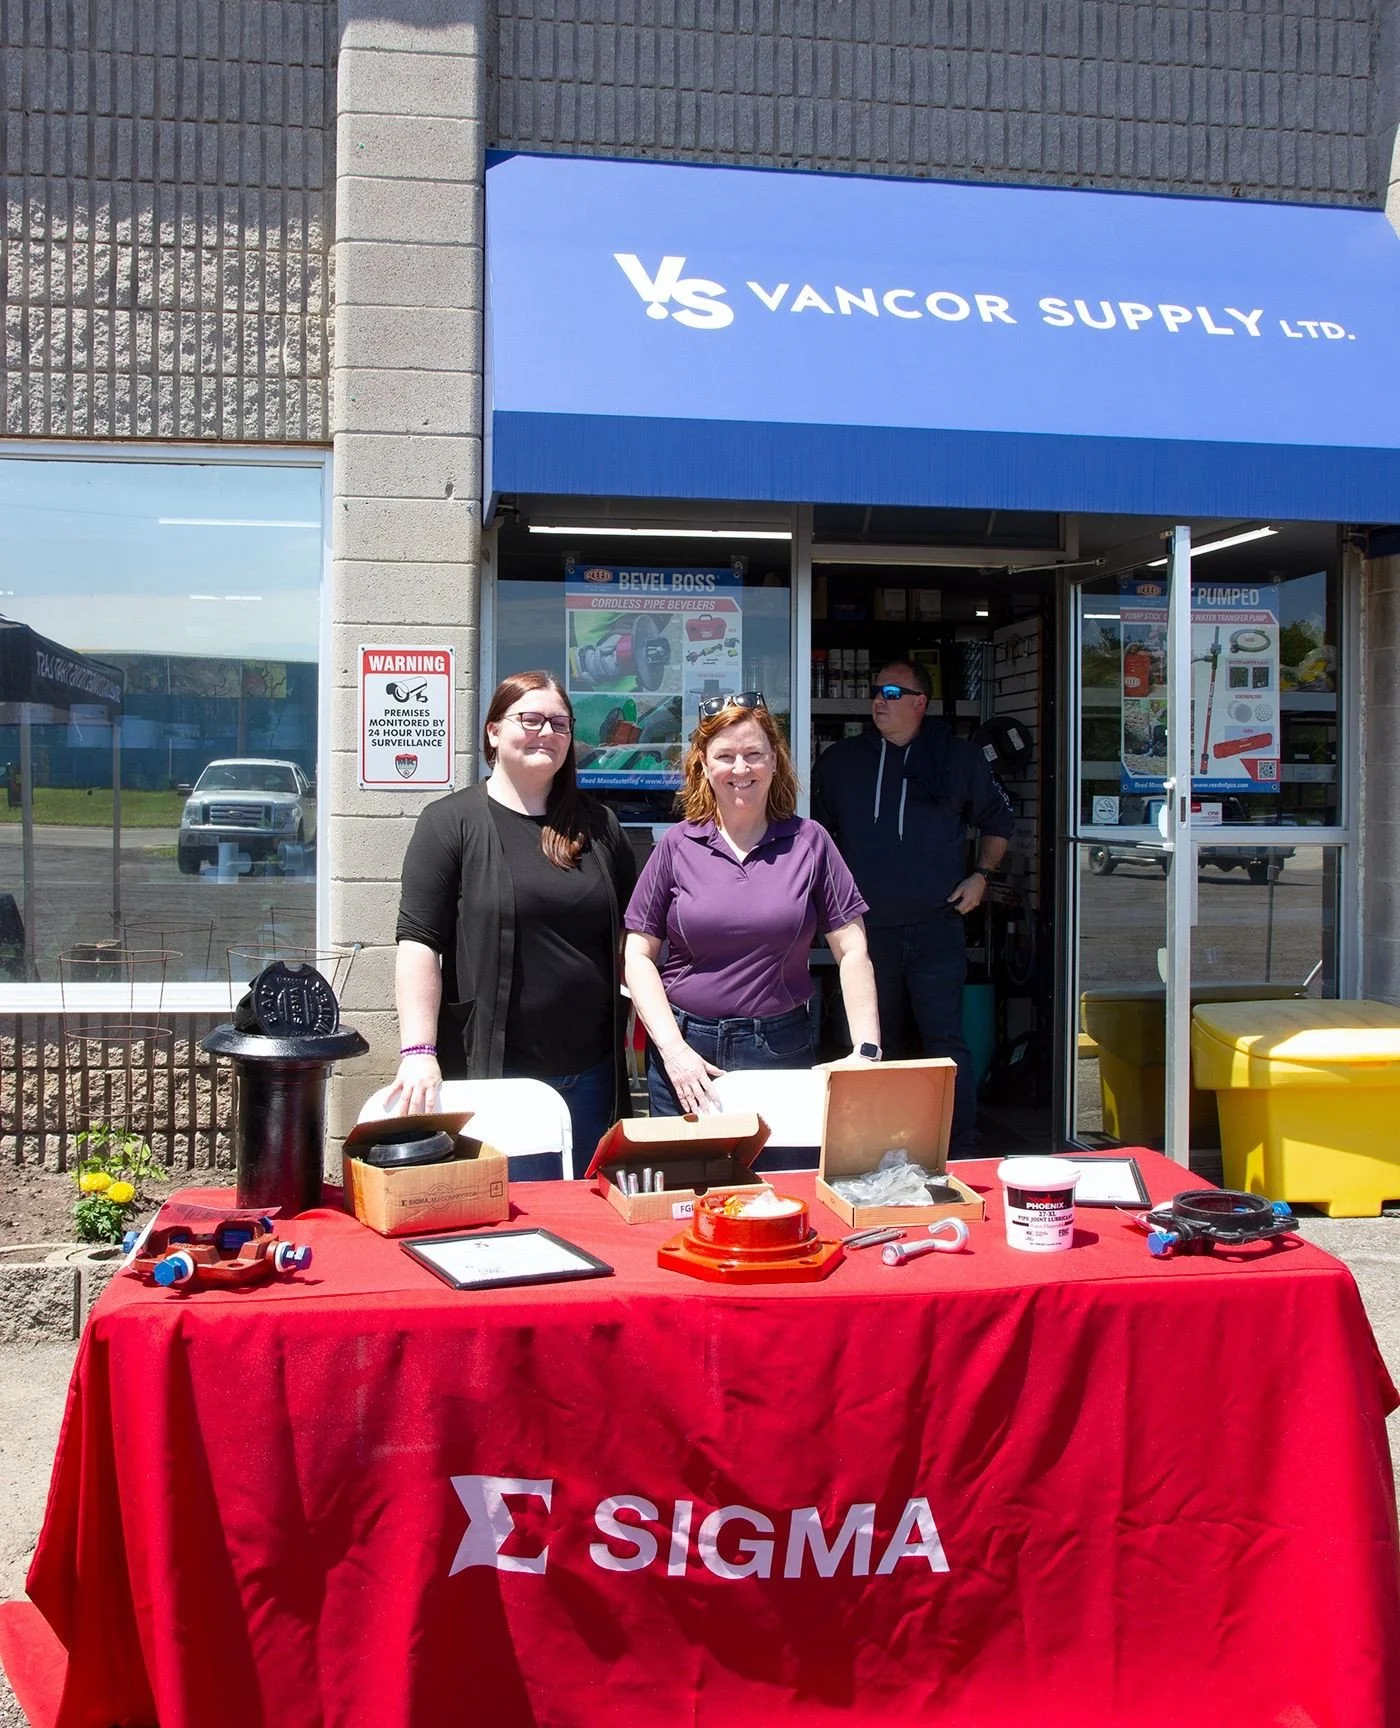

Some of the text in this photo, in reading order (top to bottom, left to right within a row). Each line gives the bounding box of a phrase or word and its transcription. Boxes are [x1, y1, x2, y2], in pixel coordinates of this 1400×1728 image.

[746, 281, 1018, 325] VANCOR
[1038, 298, 1264, 337] SUPPLY
[1281, 320, 1356, 341] LTD.
[618, 571, 716, 592] BEVEL BOSS
[1197, 587, 1260, 606] PUMPED
[591, 597, 716, 611] CORDLESS PIPE BEVELERS
[1125, 612, 1144, 620] PUMP
[1194, 613, 1216, 621] WATER
[1216, 614, 1249, 622] TRANSFER
[1249, 614, 1268, 622] PUMP
[368, 655, 445, 672] WARNING
[384, 708, 430, 717] PREMISES
[369, 719, 445, 727] MONITORED BY
[368, 728, 446, 737] 24 HOUR VIDEO
[371, 738, 443, 747] SURVEILLANCE
[580, 776, 596, 784] Reed
[1026, 1202, 1064, 1210] PHOENIX
[589, 1494, 950, 1580] SIGMA
